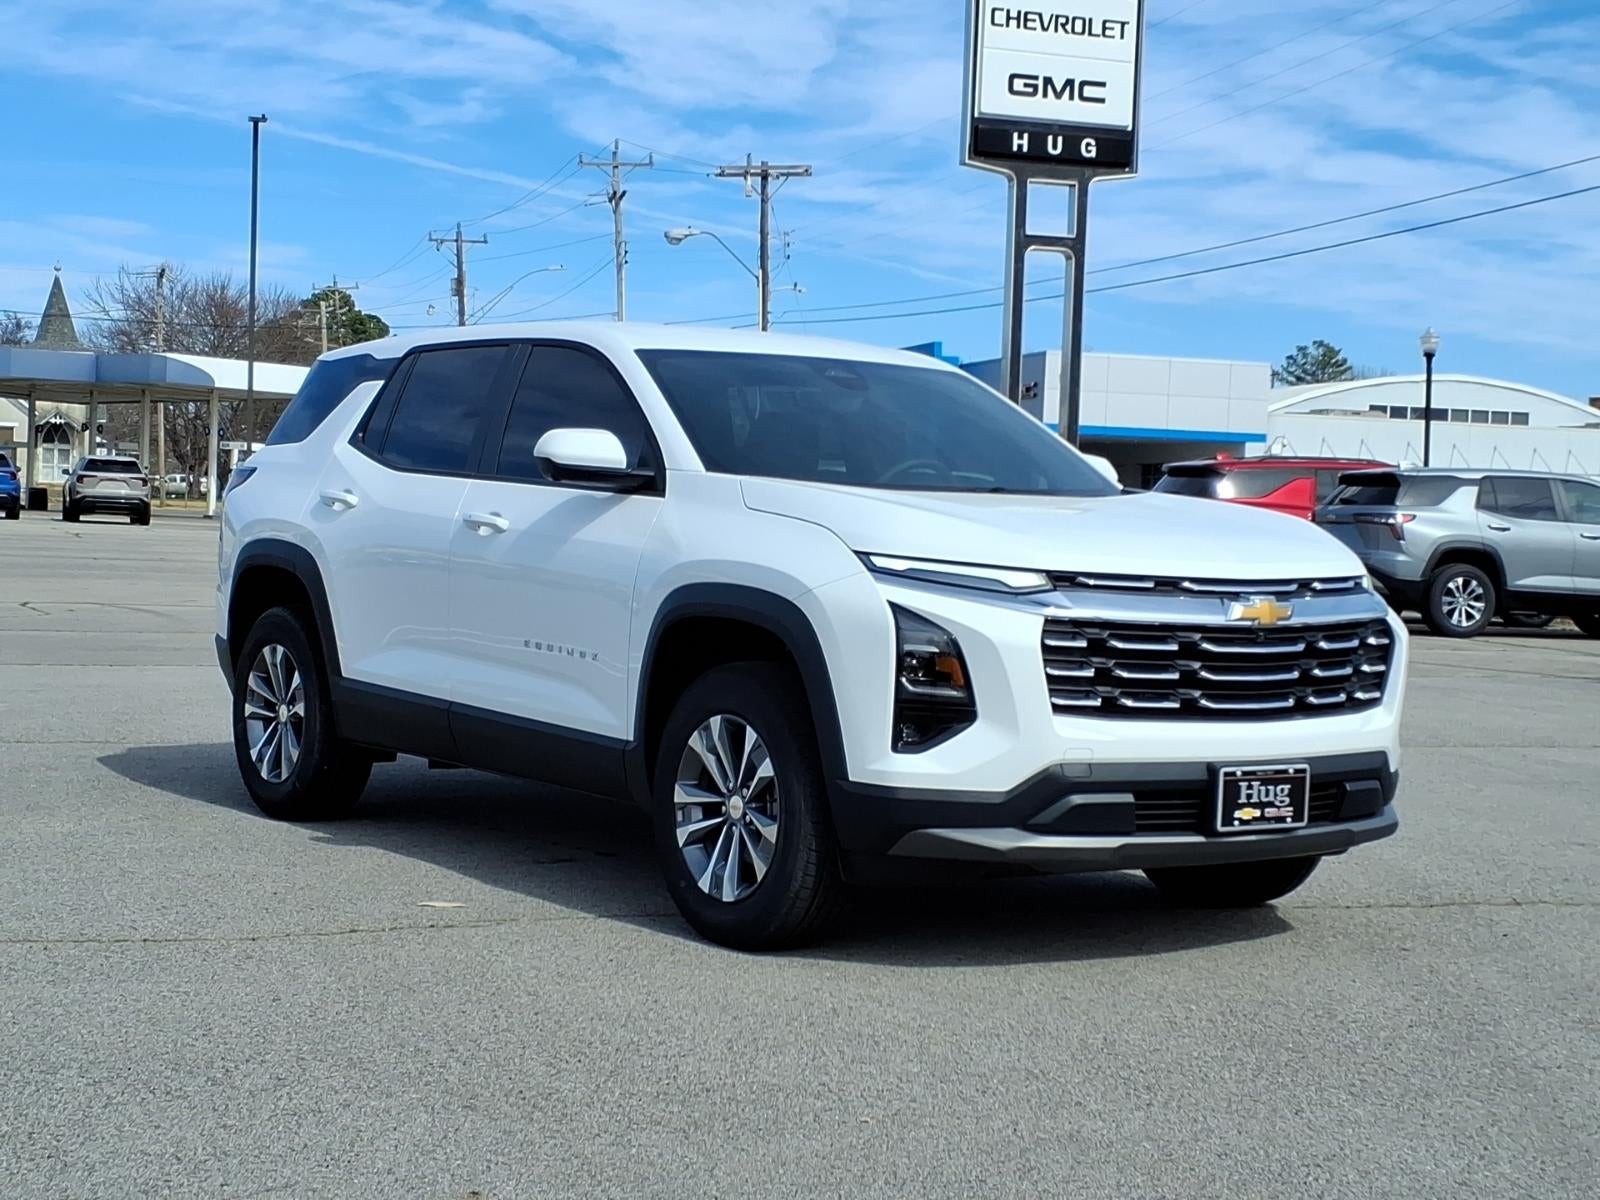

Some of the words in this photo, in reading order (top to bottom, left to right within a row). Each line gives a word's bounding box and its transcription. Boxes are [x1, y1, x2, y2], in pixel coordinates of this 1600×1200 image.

[990, 7, 1130, 40] CHEVROLET
[1007, 72, 1107, 104] GMC
[1012, 131, 1097, 159] HUG
[1237, 781, 1292, 807] Hug
